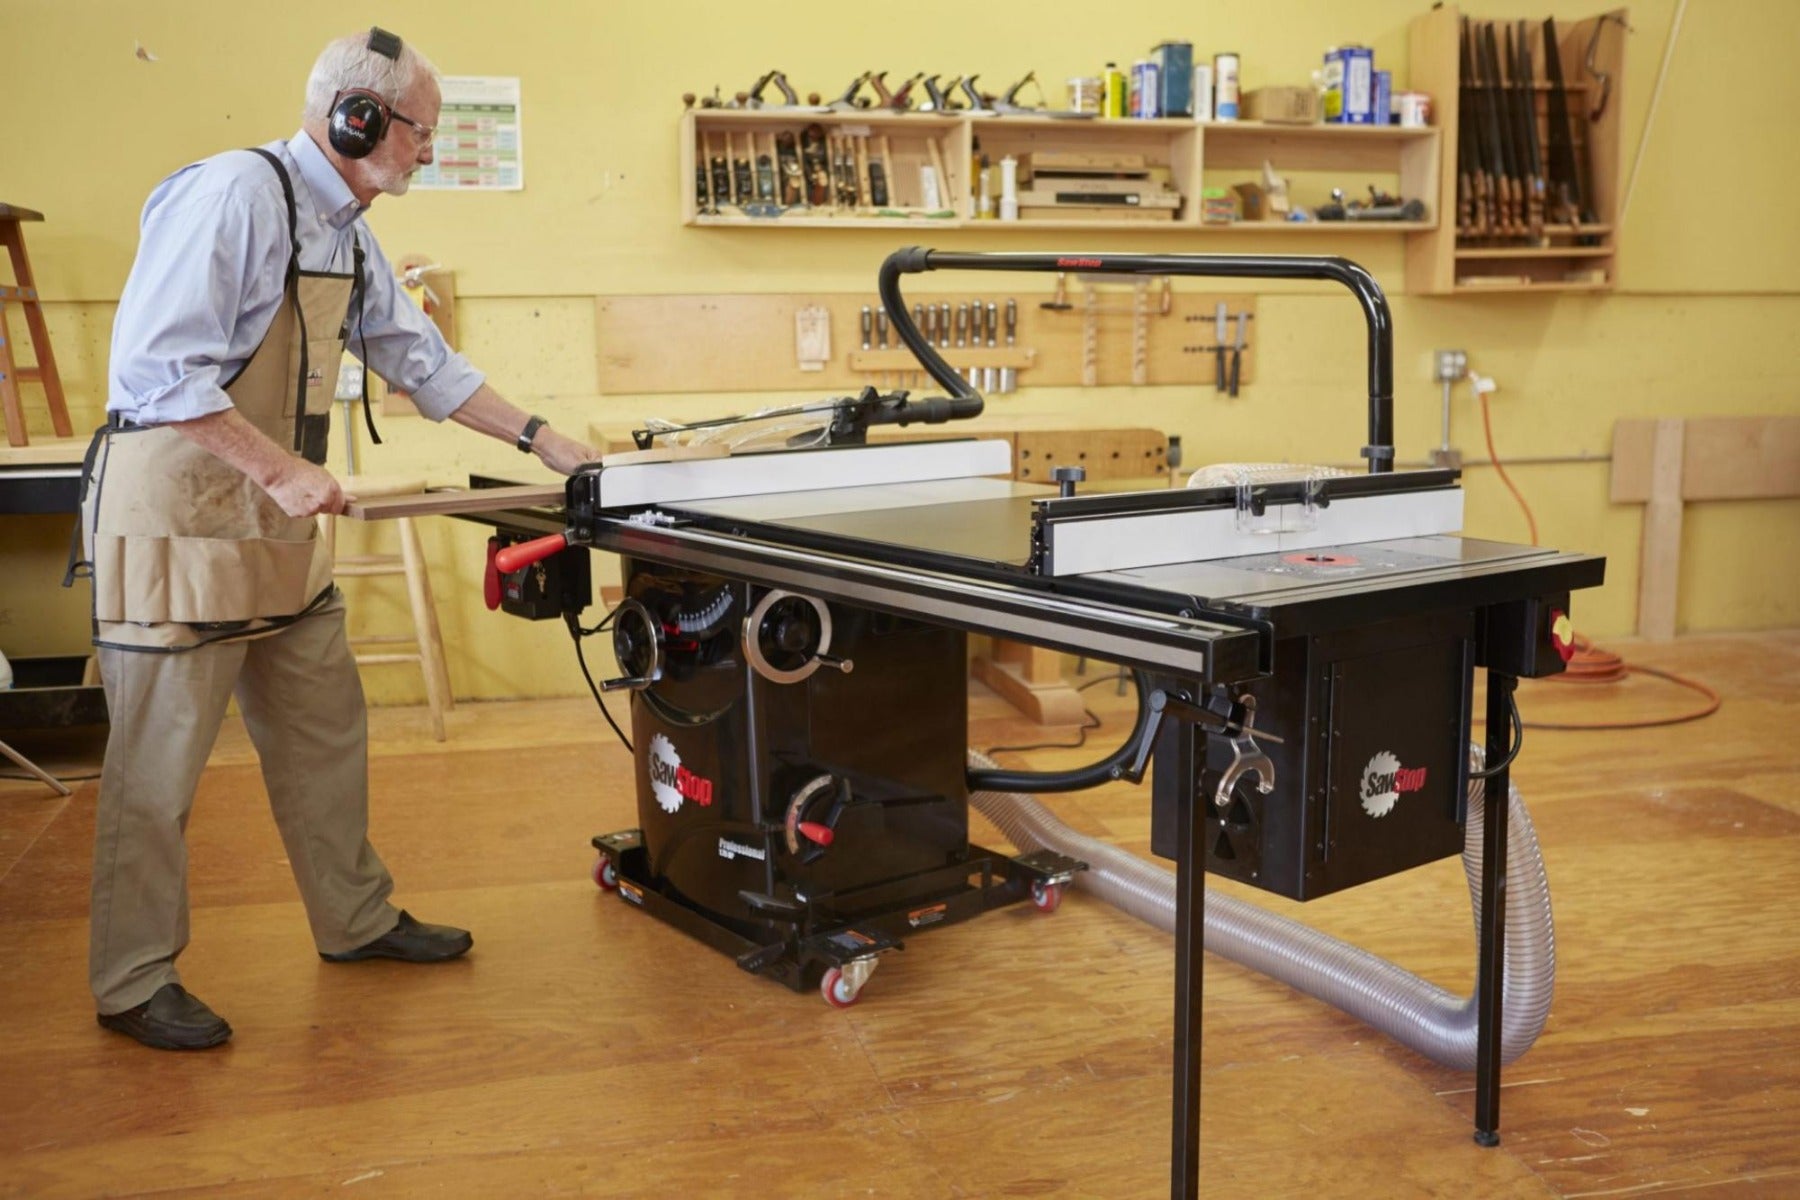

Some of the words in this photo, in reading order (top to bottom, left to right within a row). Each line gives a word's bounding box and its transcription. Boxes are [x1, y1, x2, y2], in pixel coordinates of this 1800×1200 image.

[652, 752, 713, 807] SawStop
[1366, 767, 1427, 798] SawStop
[719, 837, 766, 861] Professional
